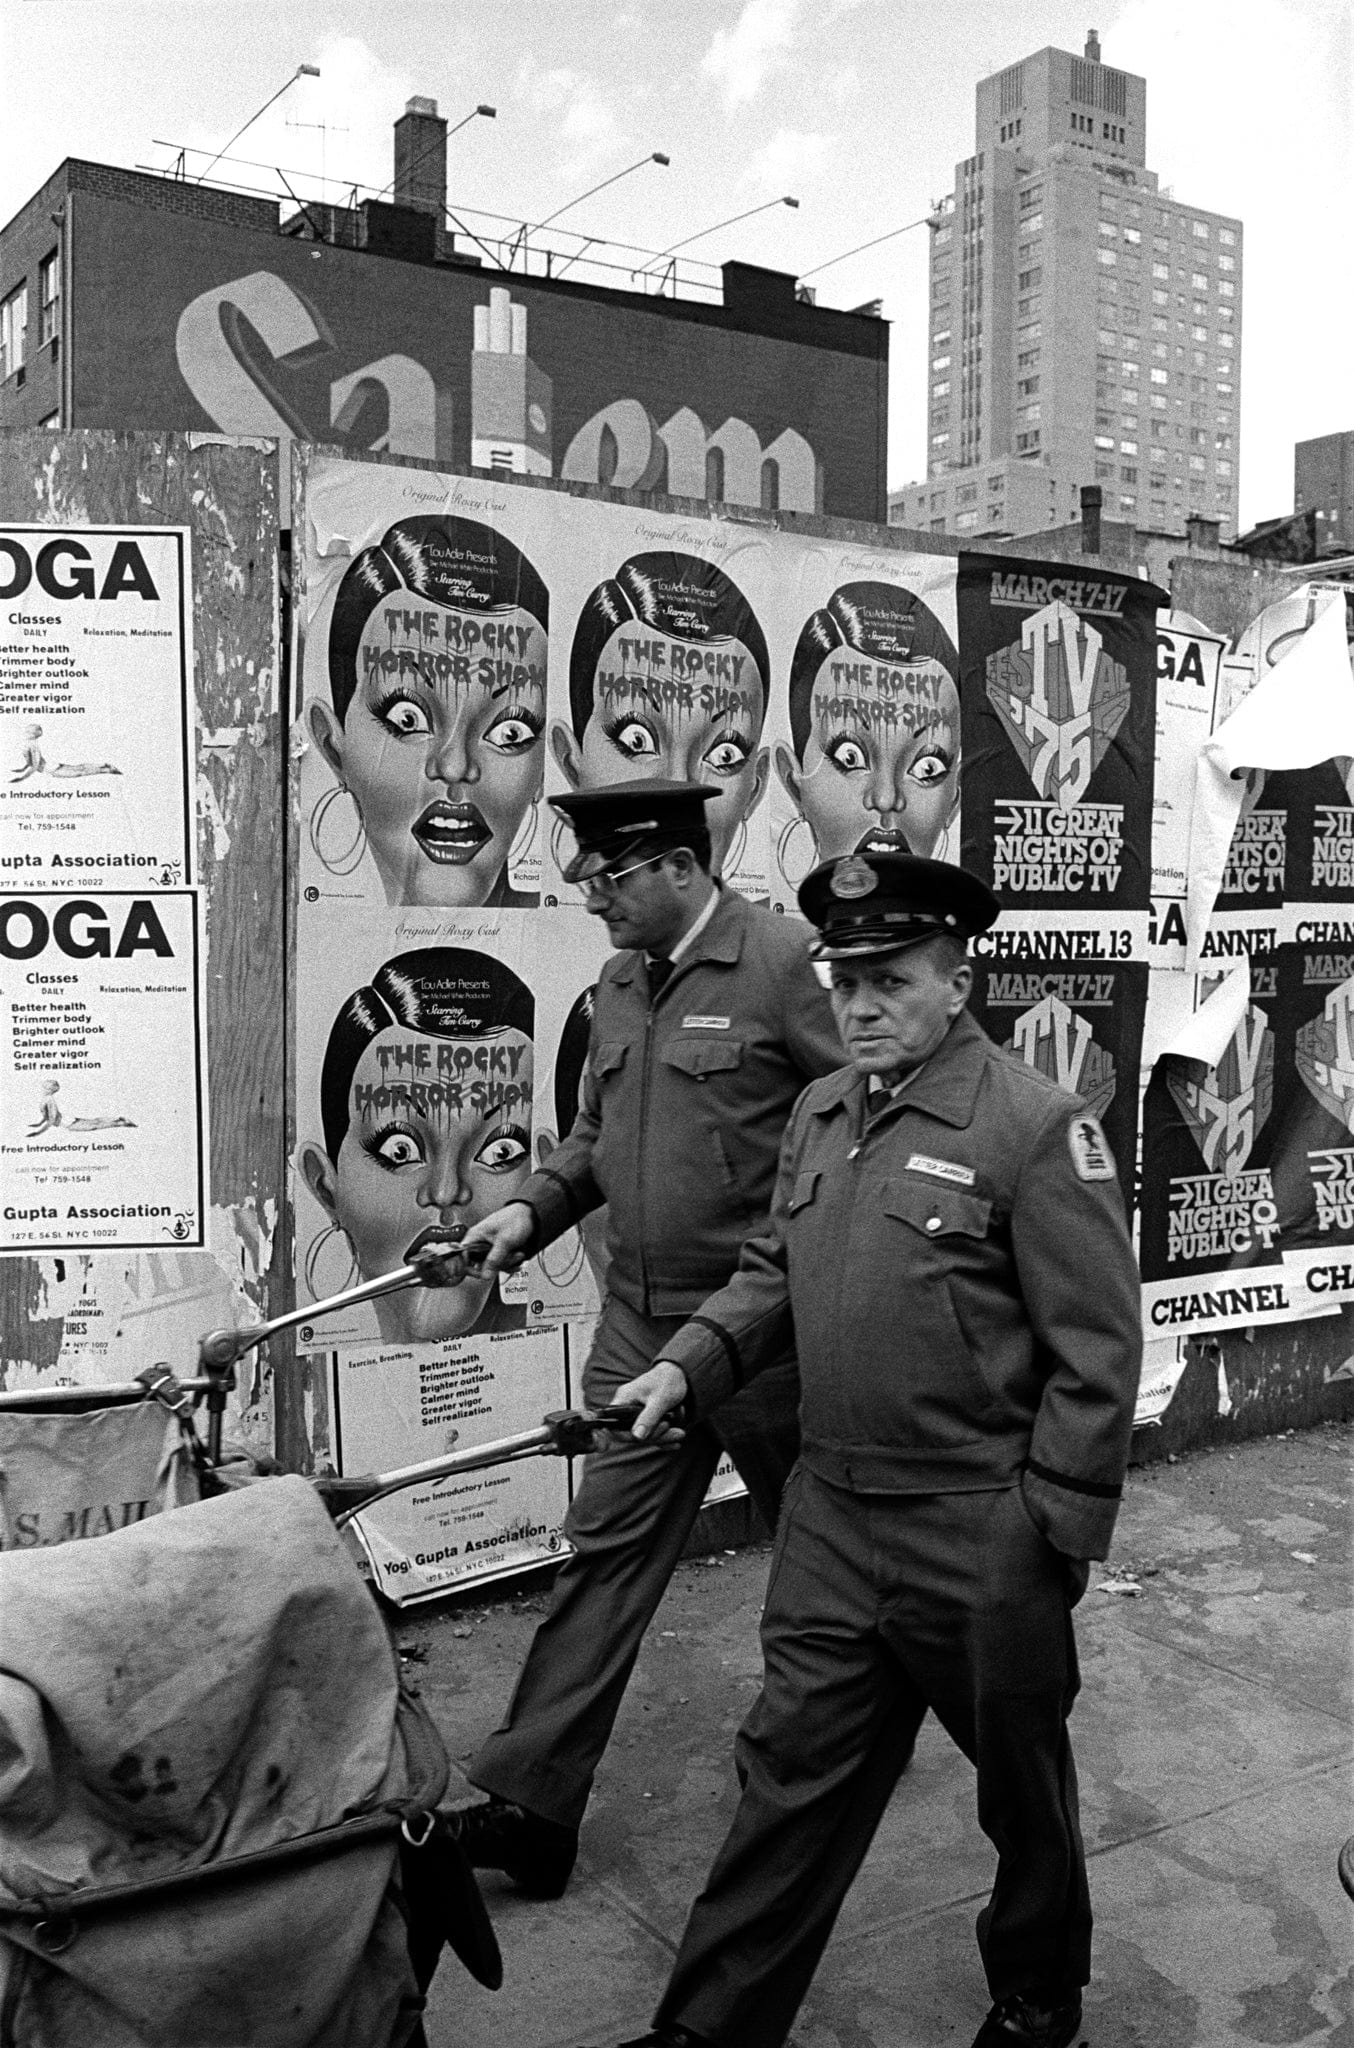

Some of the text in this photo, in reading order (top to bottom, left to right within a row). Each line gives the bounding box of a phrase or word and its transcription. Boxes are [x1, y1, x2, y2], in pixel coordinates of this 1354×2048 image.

[0, 538, 161, 600] OGA
[990, 571, 1128, 611] MARCH 7-17
[8, 612, 63, 625] Classes
[23, 628, 48, 637] DAILY
[83, 627, 173, 638] Relaxation, Meditation
[384, 608, 536, 660] THE ROCKY
[0, 644, 70, 653] etter health
[0, 657, 76, 667] rimmer body
[617, 636, 748, 684] THE ROCKY
[1157, 634, 1206, 688] GA
[45, 668, 90, 678] outlook
[362, 644, 472, 698] HORROR
[40, 681, 70, 690] mind
[830, 662, 945, 702] THE ROCKY
[43, 693, 73, 704] vigor
[600, 671, 695, 718] HORROR
[22, 704, 86, 714] realization
[814, 694, 899, 736] HORROR
[10, 790, 74, 800] Introductory
[76, 789, 111, 799] Lesson
[37, 822, 77, 831] 759-1548
[1046, 808, 1124, 838] GREAT
[1232, 815, 1287, 842] GREA
[993, 835, 1123, 865] NIGHTS OF
[1, 853, 159, 869] upta Association
[78, 878, 103, 886] 10022
[992, 863, 1122, 892] PUBLIC TV
[0, 900, 175, 960] OGA
[394, 923, 501, 940] Original Roxy Cast
[973, 929, 1132, 960] CHANNEL 13
[1199, 928, 1280, 958] ANNEL
[26, 972, 79, 984] Classes
[436, 978, 457, 990] Adler
[457, 978, 490, 990] Presents
[987, 972, 1116, 1001] MARCH 7-17
[100, 985, 187, 994] Relaxation, Meditation
[12, 1002, 87, 1012] Better health
[426, 1003, 465, 1018] Starring
[12, 1014, 92, 1025] Trimmer body
[12, 1025, 105, 1037] Brighter outlook
[13, 1037, 86, 1048] Calmer mind
[14, 1049, 90, 1060] Greater vigor
[376, 1044, 527, 1080] THE ROCKY
[14, 1060, 102, 1071] Self realization
[354, 1082, 464, 1126] HORROR
[1, 1142, 125, 1154] Free Introductory Lesson
[53, 1175, 92, 1184] 759-1548
[1213, 1173, 1275, 1204] GREA
[4, 1203, 172, 1222] Gupta Association
[1167, 1201, 1251, 1237] NIGHTS
[1252, 1199, 1278, 1224] O
[92, 1228, 118, 1238] 10022
[1166, 1222, 1282, 1263] PUBLIC T
[1151, 1283, 1291, 1327] CHANNEL
[443, 1343, 463, 1352] DAILY
[348, 1358, 378, 1368] Exercise,
[419, 1354, 480, 1373] Better health
[420, 1364, 484, 1384] Trimmer body
[420, 1372, 496, 1395] Brighter outlook
[420, 1385, 480, 1406] Calmer mind
[421, 1397, 483, 1417] Greater vigor
[422, 1405, 493, 1427] Self realization
[412, 1475, 511, 1506] Free Introductory Lesson
[453, 1510, 485, 1525] 759-1548
[383, 1556, 412, 1577] Yogi
[415, 1544, 459, 1567] Gupta
[464, 1523, 547, 1554] Association
